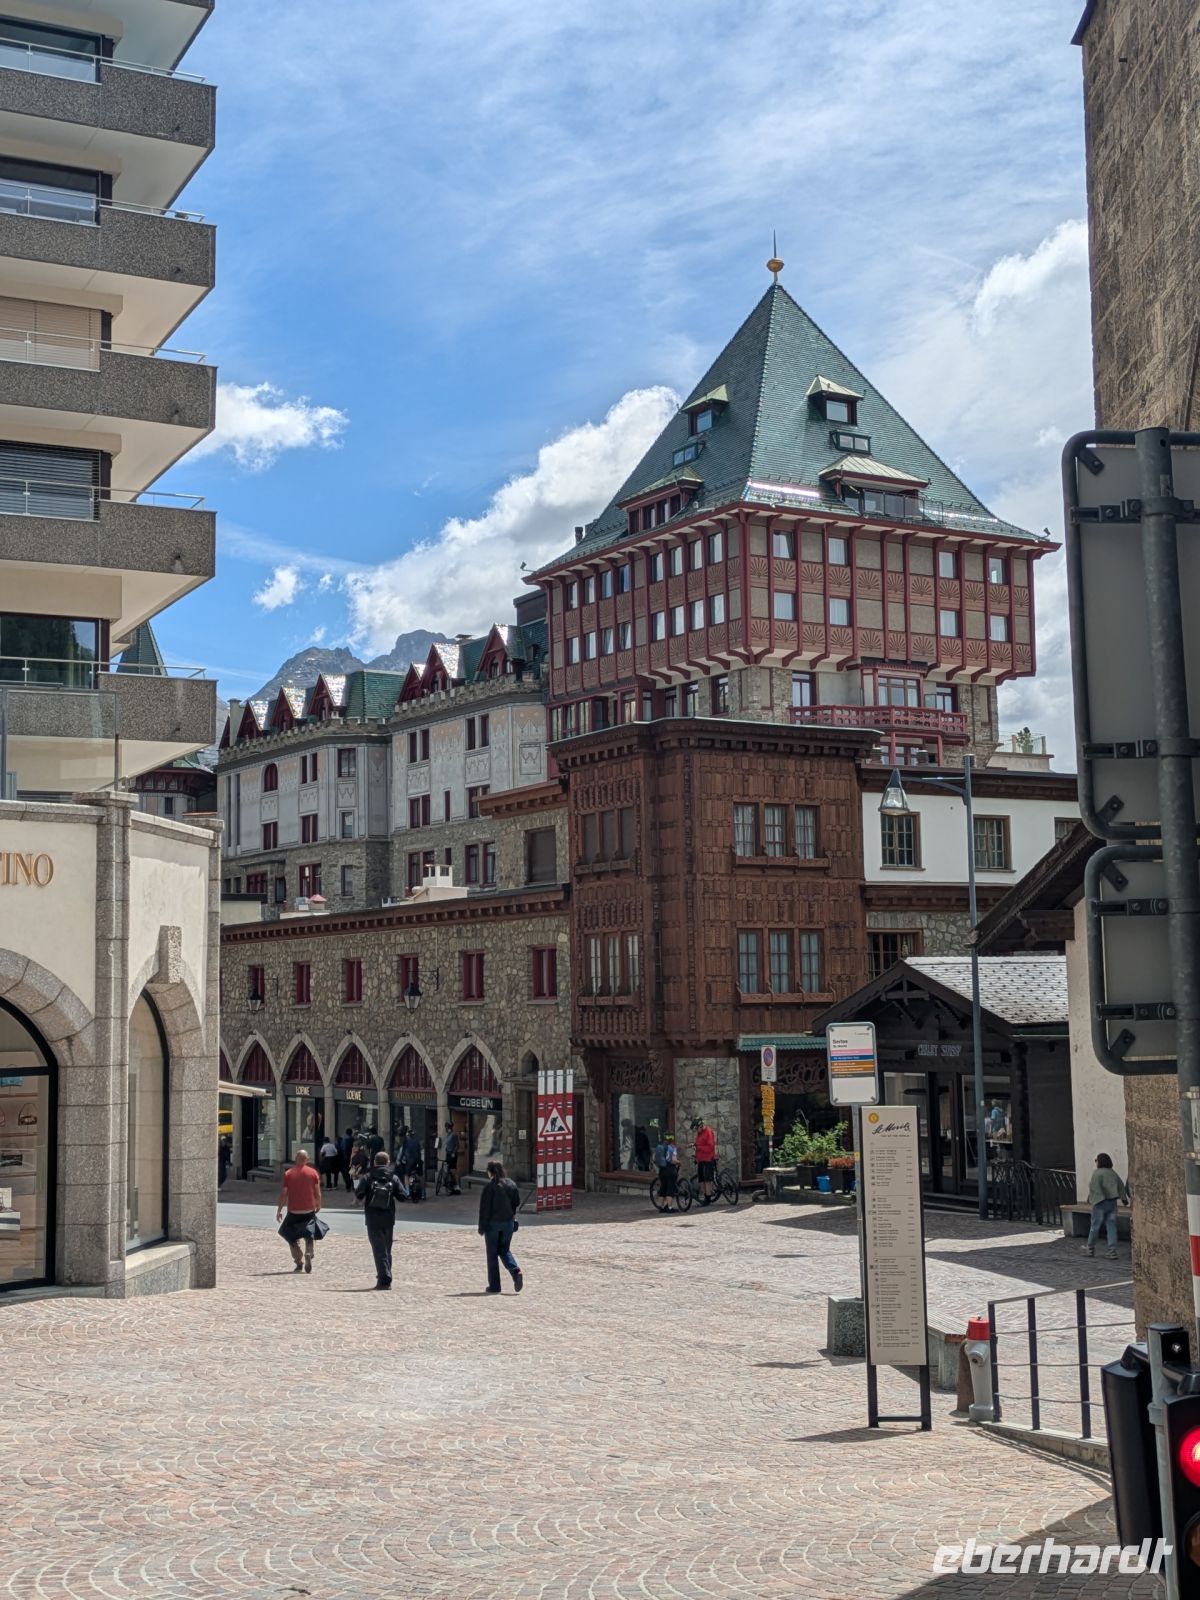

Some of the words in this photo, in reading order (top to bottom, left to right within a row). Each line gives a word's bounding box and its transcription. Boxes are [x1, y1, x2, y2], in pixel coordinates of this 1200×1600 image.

[0, 852, 54, 887] INO
[295, 1086, 310, 1096] LOEWE
[345, 1090, 361, 1100] LOEWE
